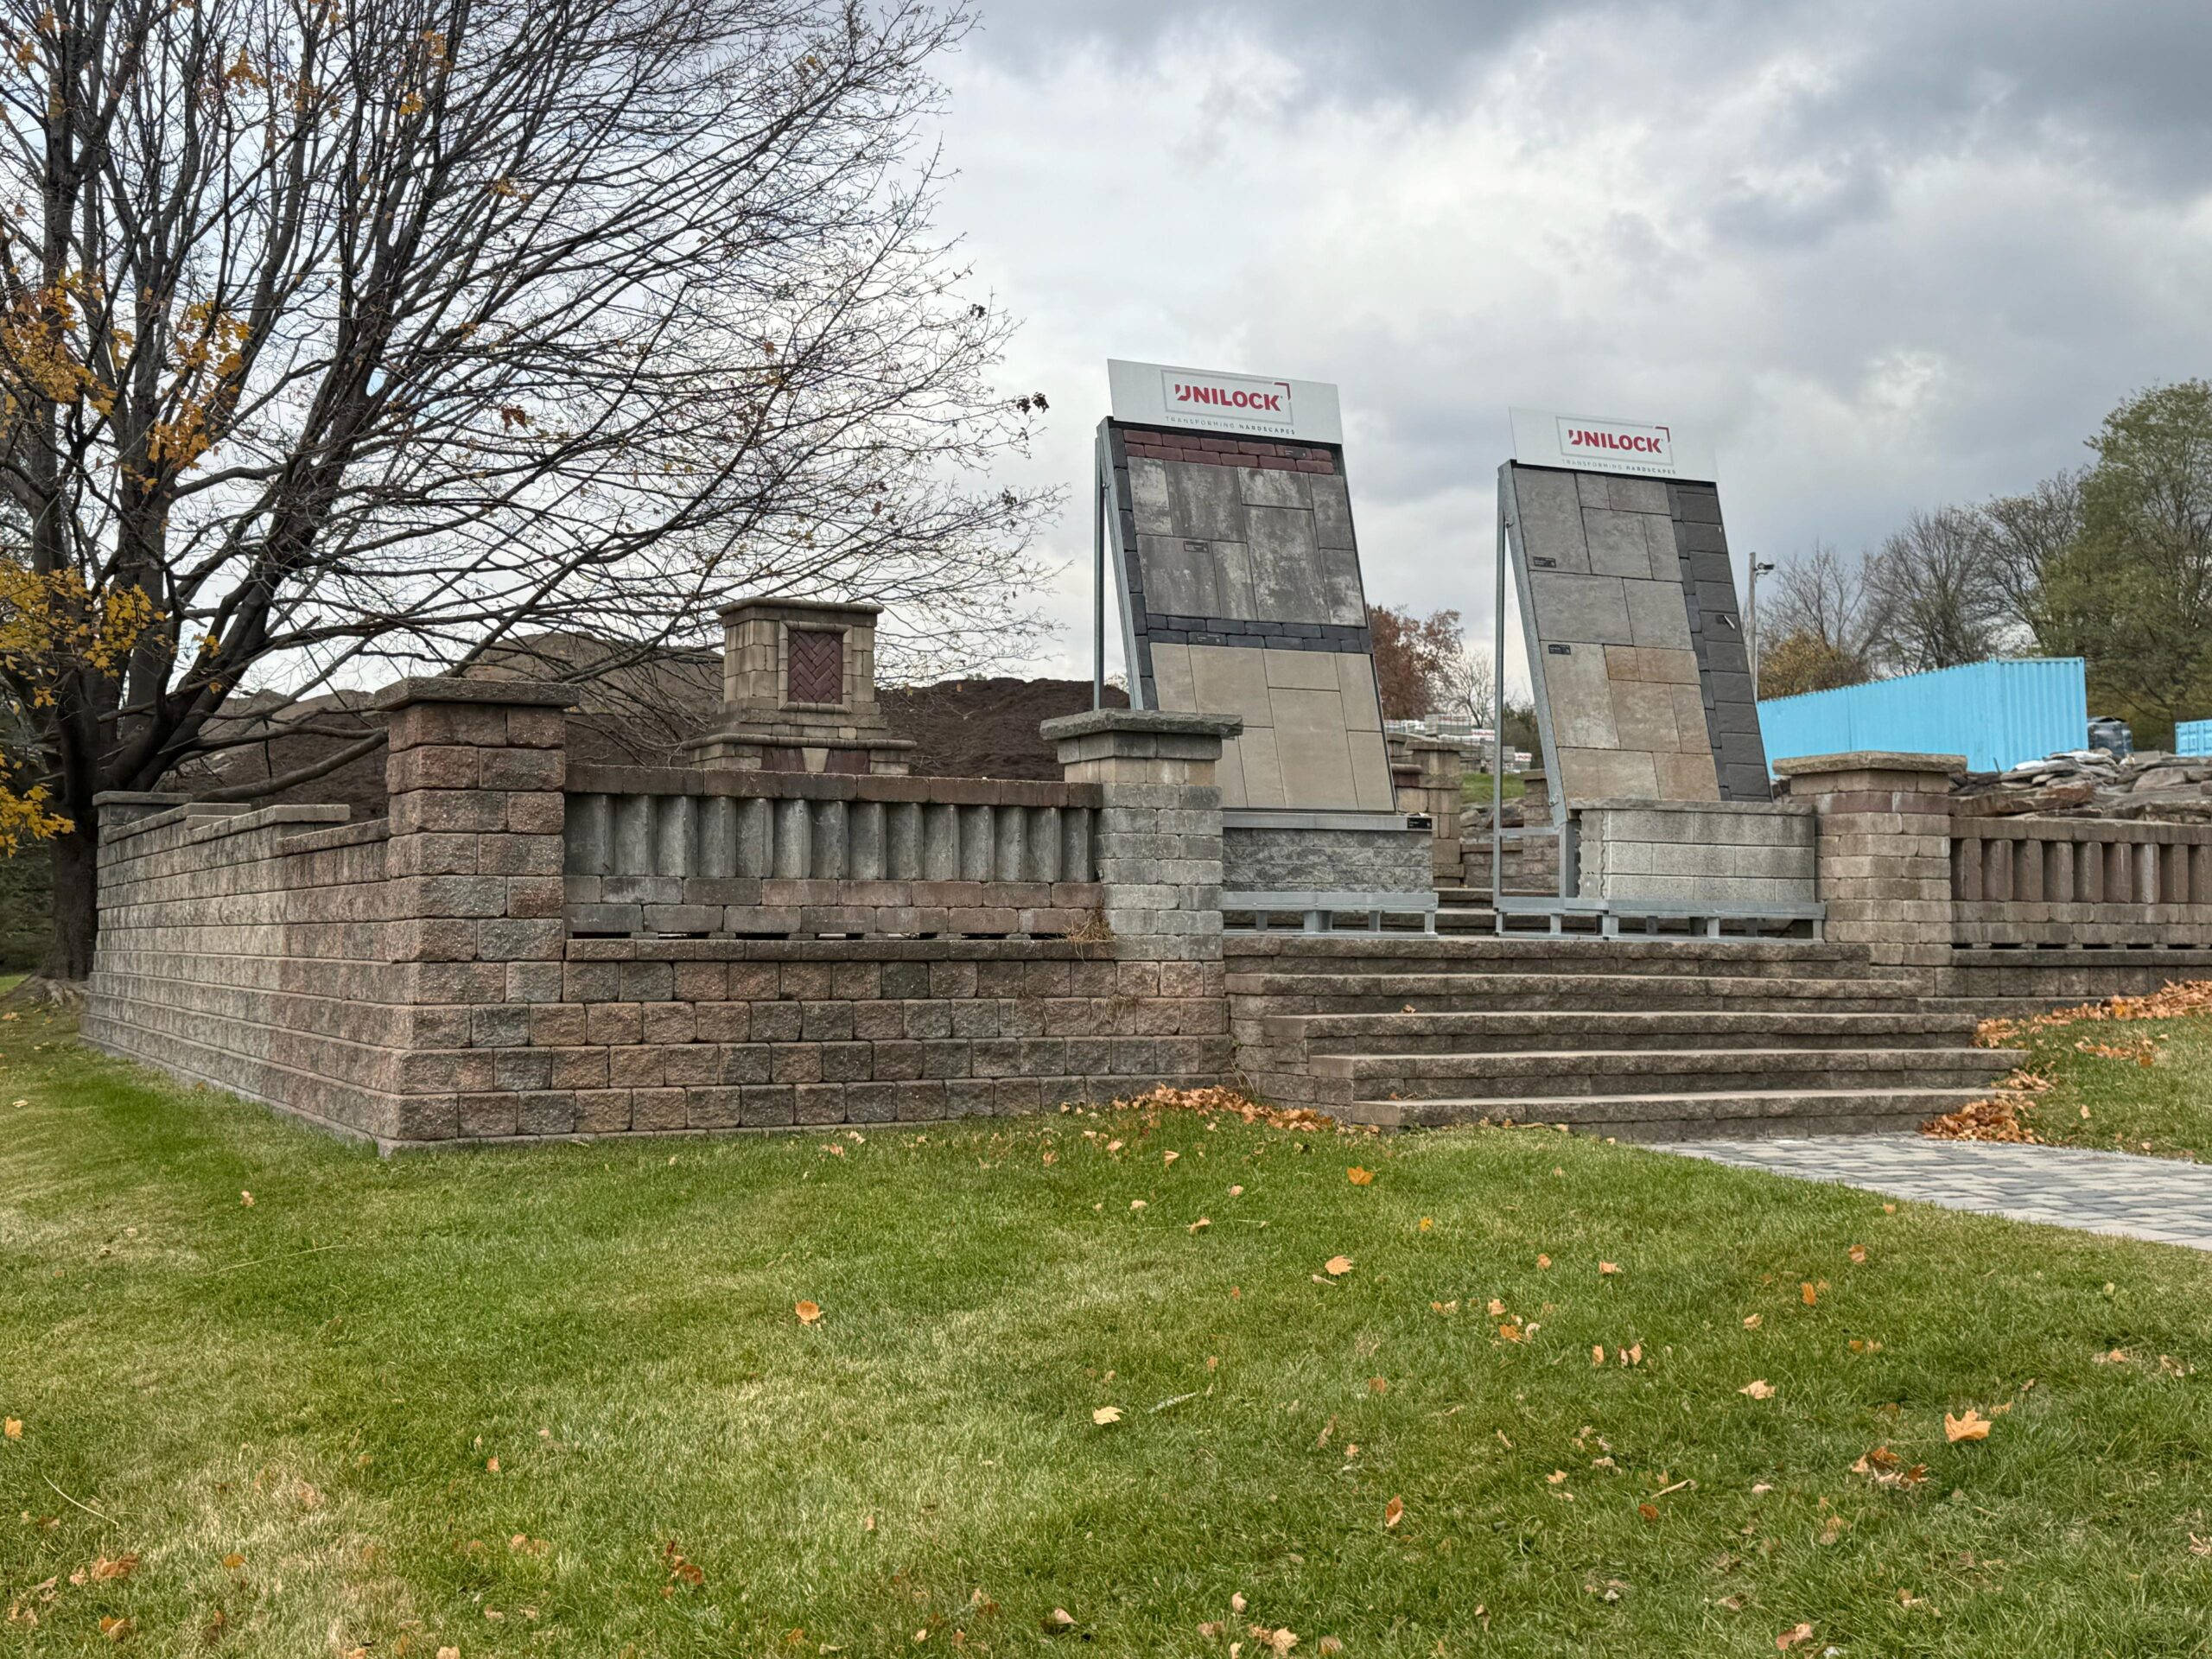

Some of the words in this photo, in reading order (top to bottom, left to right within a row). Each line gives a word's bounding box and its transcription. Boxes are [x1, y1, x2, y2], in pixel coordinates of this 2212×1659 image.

[1174, 384, 1282, 412] UNILOCK
[1166, 416, 1235, 429] TRANSFORMING
[1567, 429, 1662, 454] UNILOCK
[1562, 459, 1623, 470] TRANSFORMING
